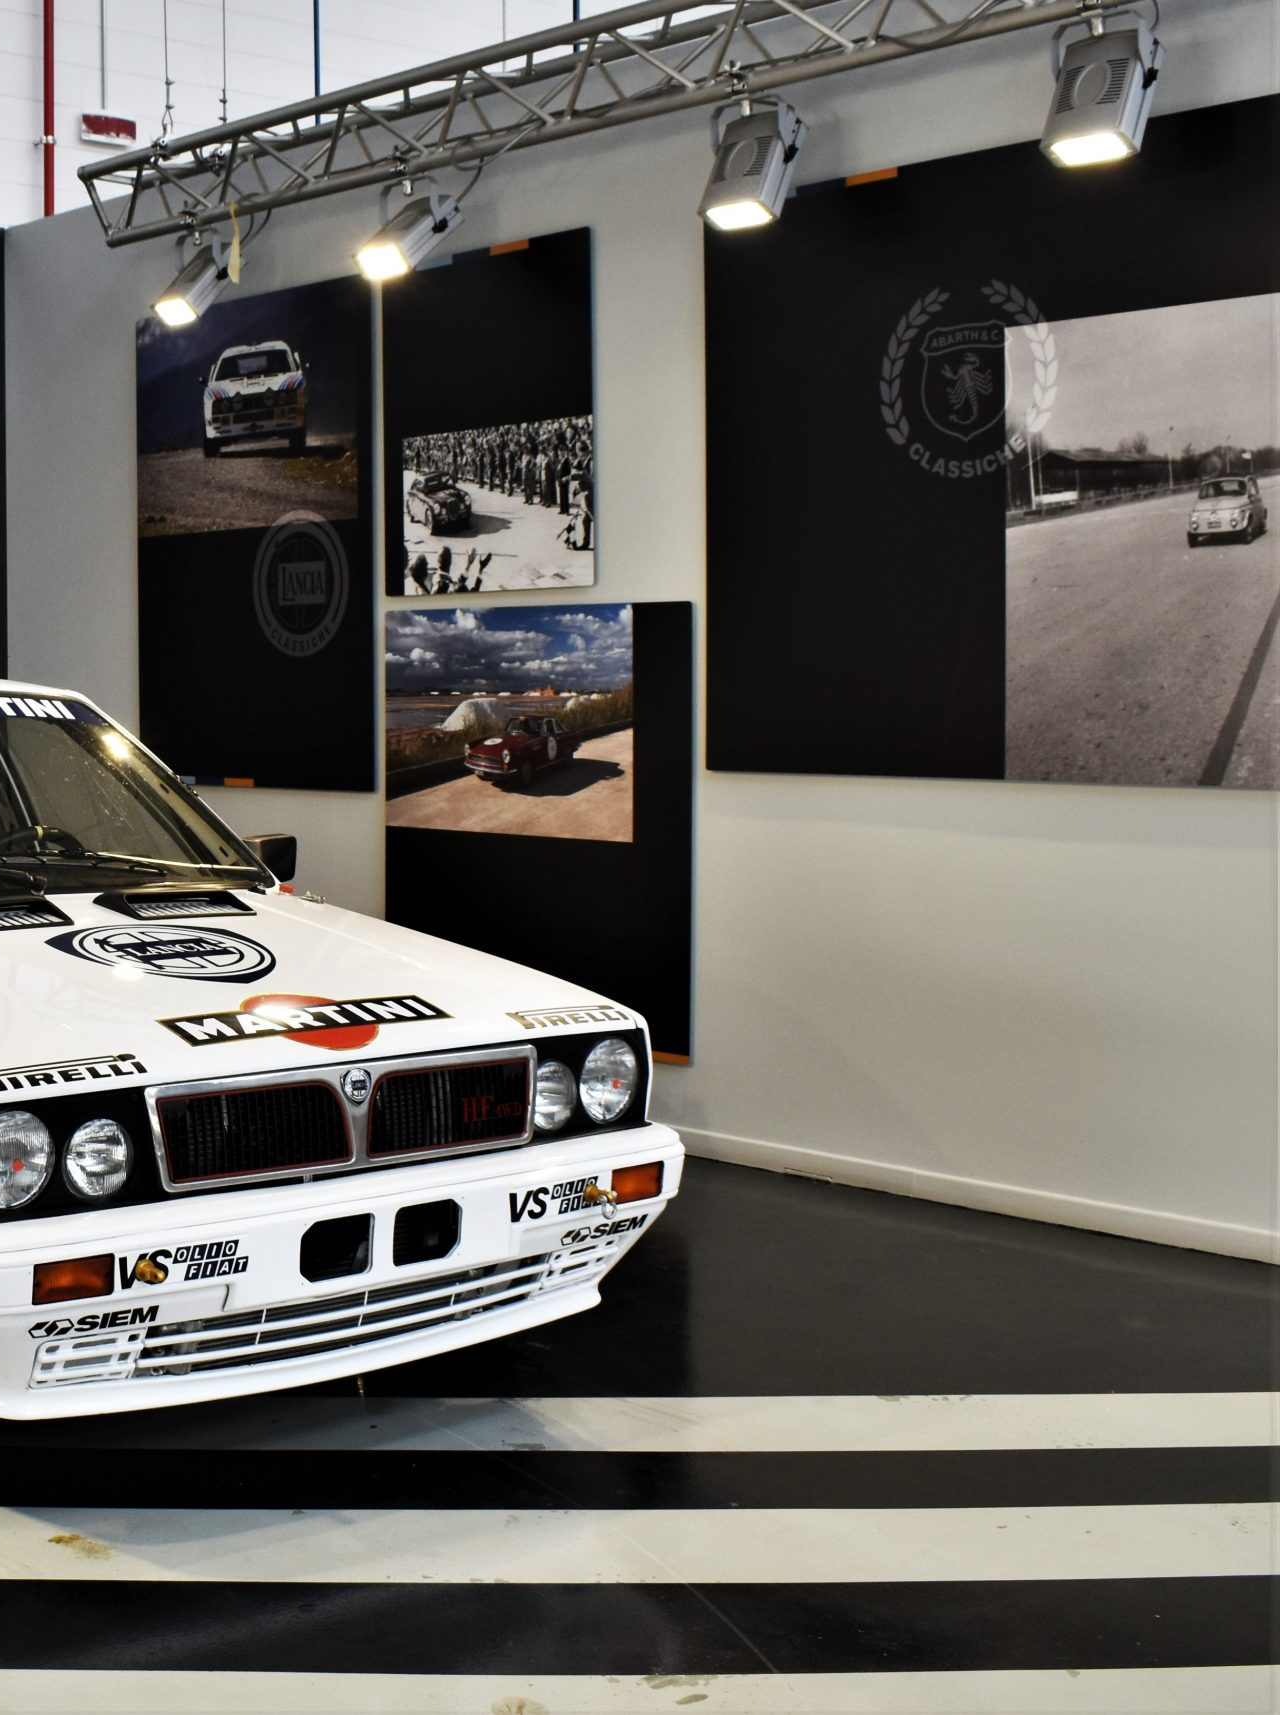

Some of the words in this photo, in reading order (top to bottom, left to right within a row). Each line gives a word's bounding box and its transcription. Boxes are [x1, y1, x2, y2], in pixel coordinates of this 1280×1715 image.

[930, 330, 979, 350] ABARTH
[909, 433, 1026, 478] CLASSICHE
[281, 566, 325, 602] LANCIA
[270, 624, 334, 652] CLASSICHE
[123, 942, 225, 957] LANCIA
[174, 998, 438, 1042] MARTINI
[504, 1005, 630, 1030] PIRELLI
[509, 1186, 550, 1223] VS
[590, 1213, 649, 1240] SIEM
[172, 1239, 240, 1265] OLIO
[119, 1249, 173, 1290] VS
[183, 1255, 249, 1282] FIAT
[73, 1304, 160, 1333] SIEM
